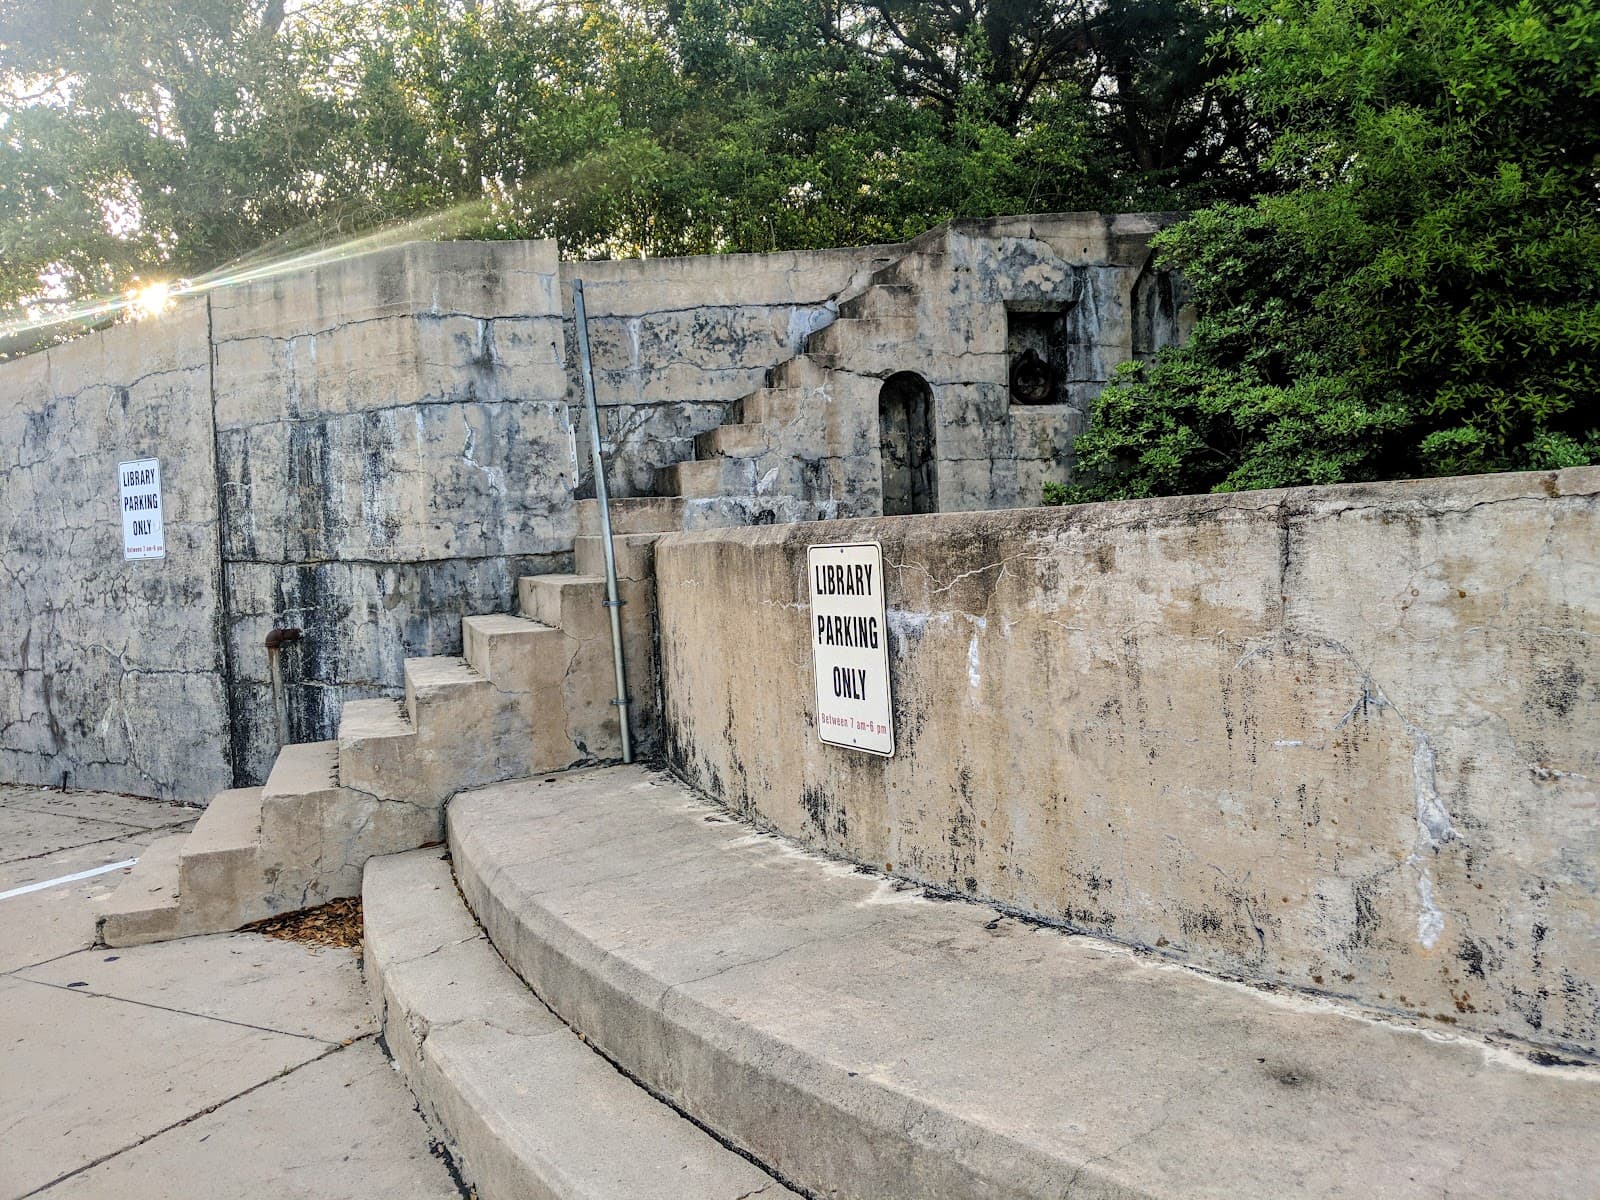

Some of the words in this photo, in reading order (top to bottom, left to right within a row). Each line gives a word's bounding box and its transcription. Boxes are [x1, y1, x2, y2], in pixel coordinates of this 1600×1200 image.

[123, 468, 155, 487] LIBRARY
[124, 493, 158, 512] PARKING
[133, 520, 152, 536] ONLY
[815, 564, 872, 595] LIBRARY
[817, 615, 878, 649] PARKING
[833, 666, 866, 700] ONLY
[821, 712, 849, 727] Between
[850, 717, 854, 728] 7
[856, 720, 875, 733] am-6
[876, 724, 887, 735] pm
